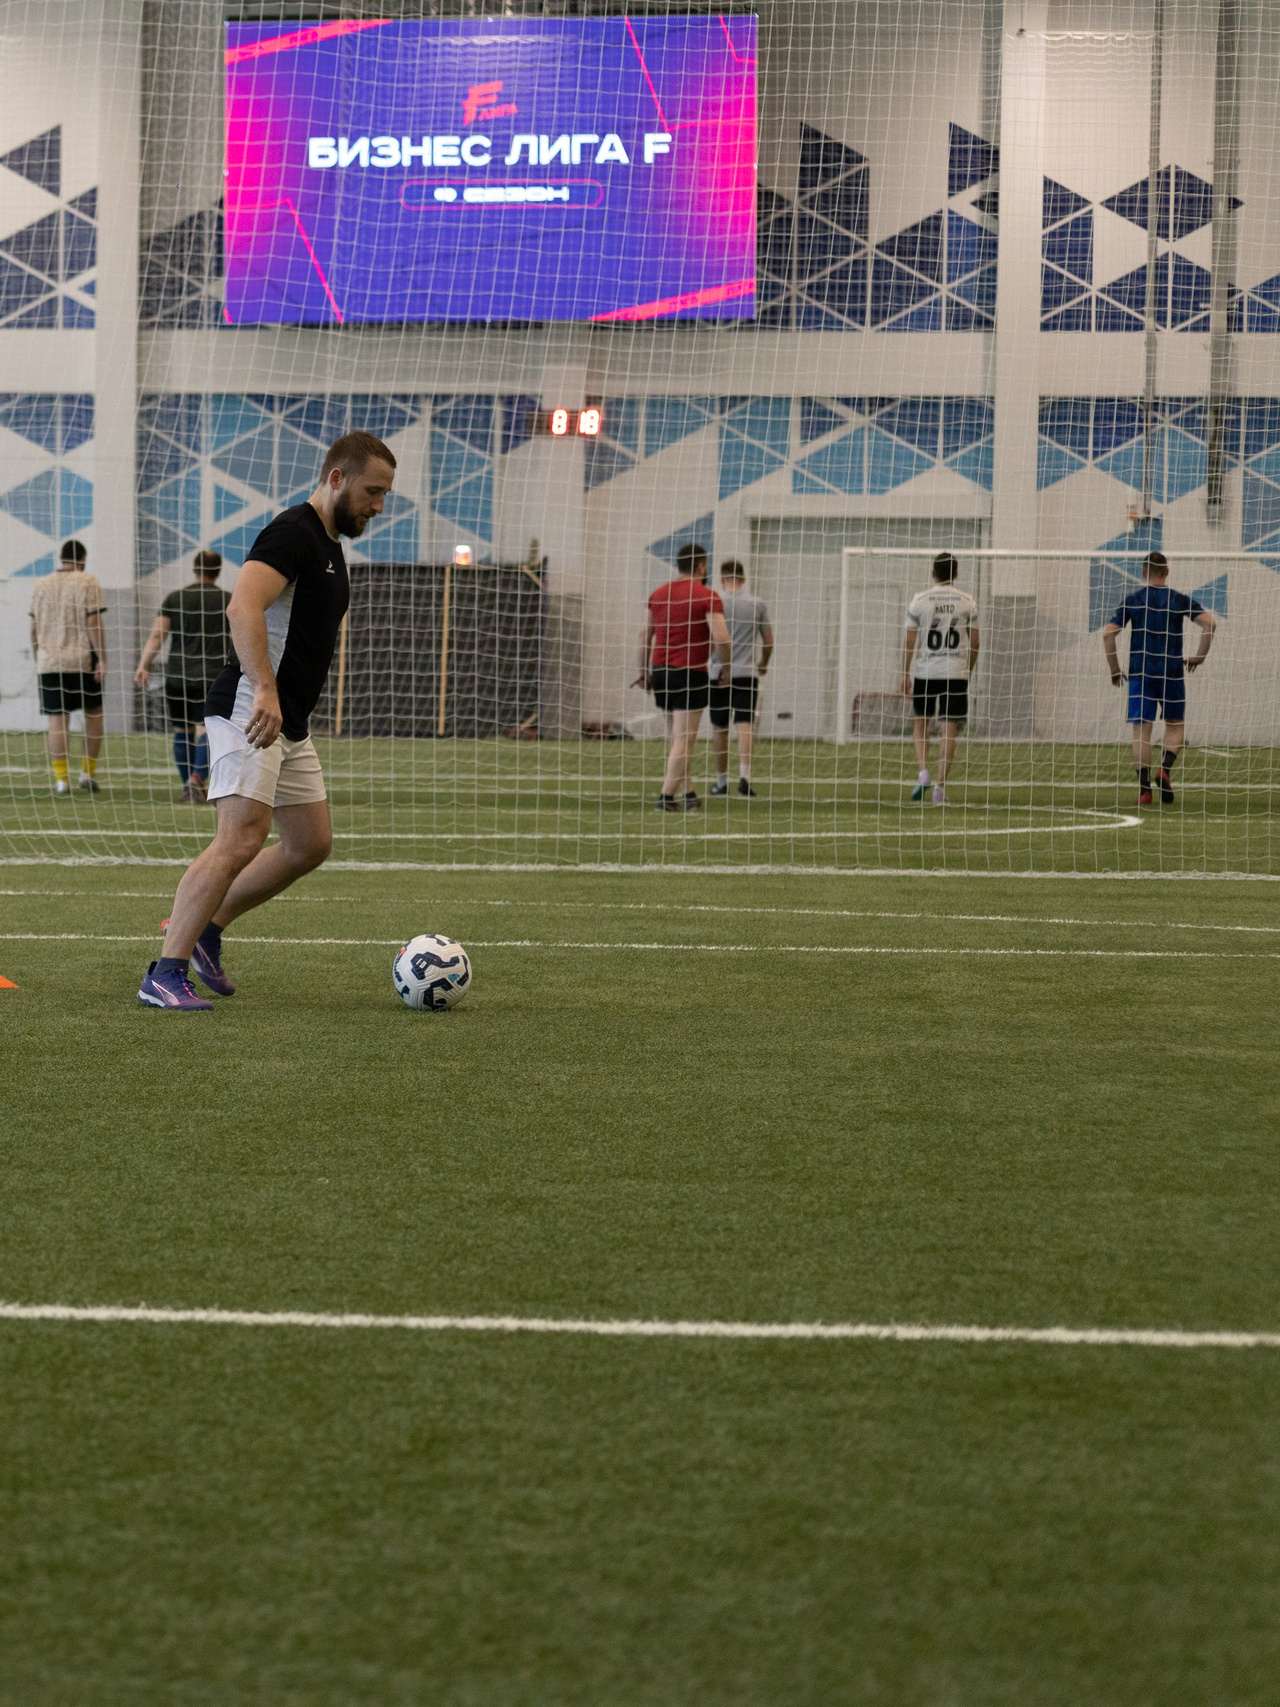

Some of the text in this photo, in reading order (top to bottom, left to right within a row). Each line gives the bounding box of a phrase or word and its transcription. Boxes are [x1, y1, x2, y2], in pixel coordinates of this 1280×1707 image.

[308, 133, 673, 168] БИЗНЕС ЛИГА F
[927, 618, 960, 651] 66
